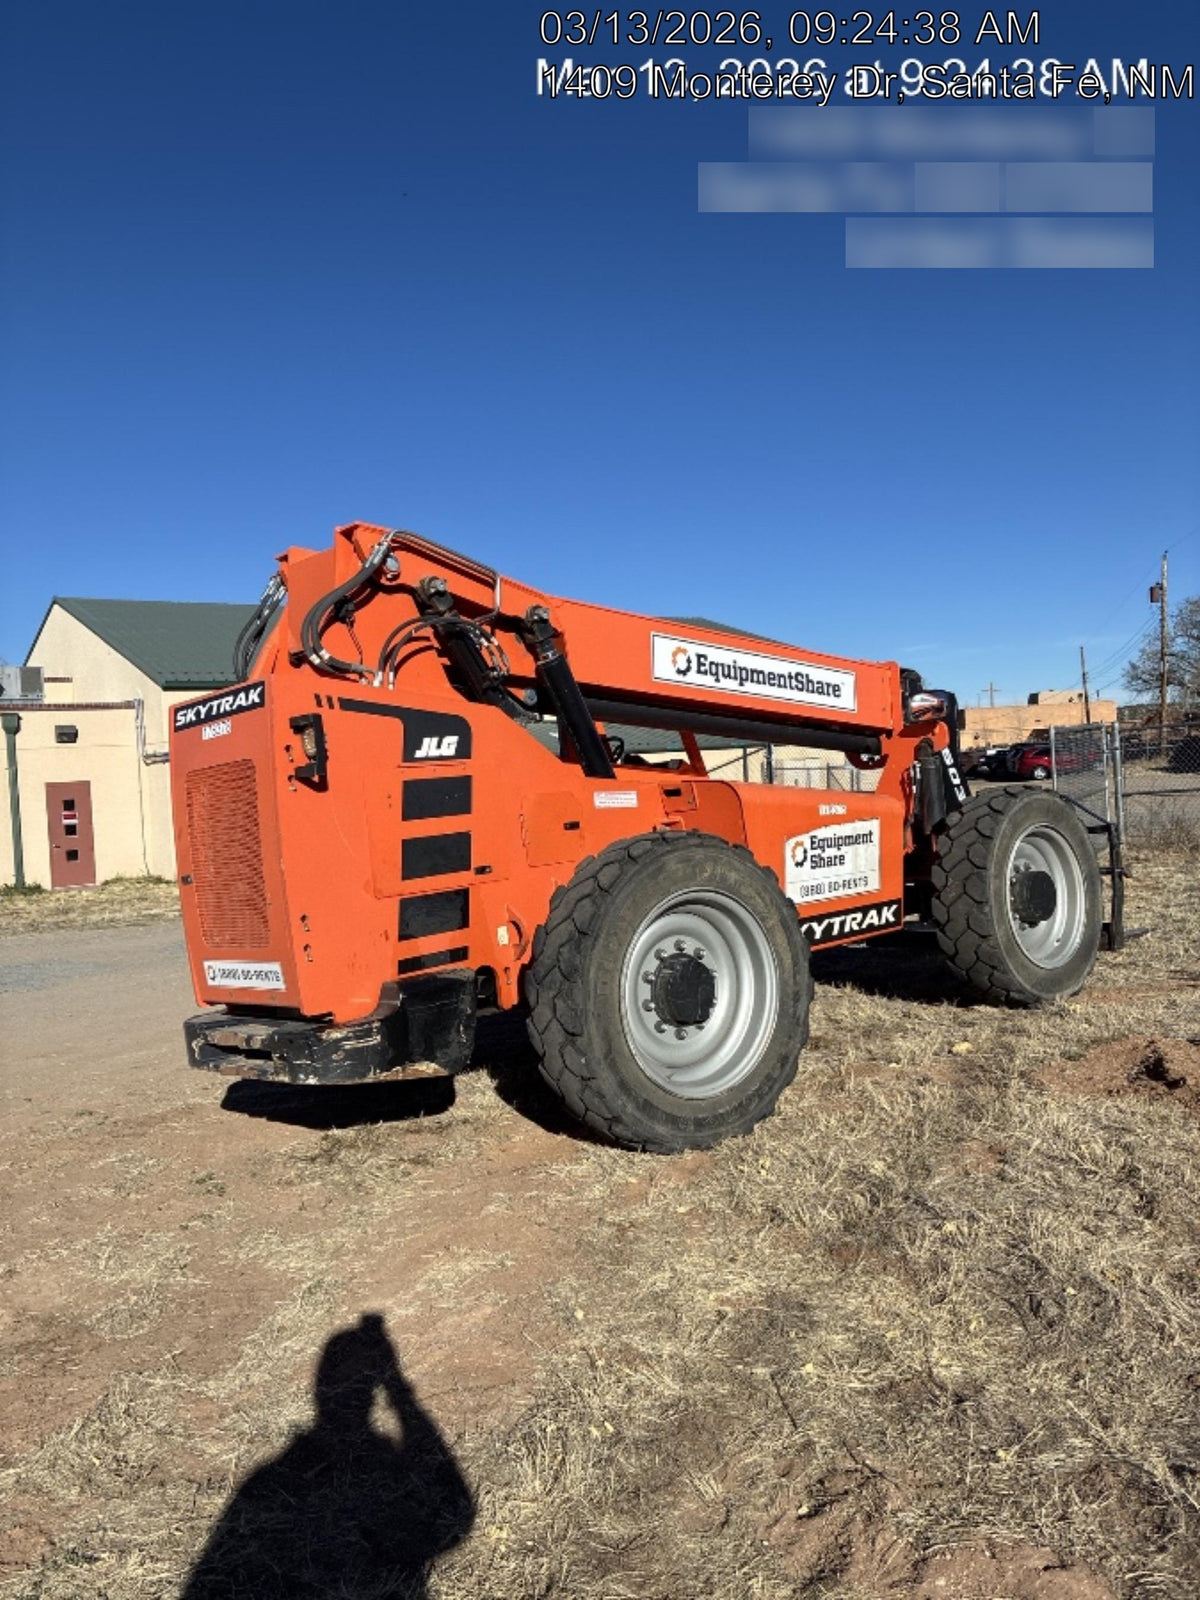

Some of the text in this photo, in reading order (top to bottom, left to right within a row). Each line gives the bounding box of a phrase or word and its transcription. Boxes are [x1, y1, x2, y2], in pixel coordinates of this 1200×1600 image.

[695, 652, 842, 698] EquipmentShare
[175, 685, 263, 727] SKYTRAK
[414, 735, 459, 758] JLG
[810, 830, 874, 853] Equipment
[810, 853, 846, 870] Share
[801, 904, 898, 939] YTRAK
